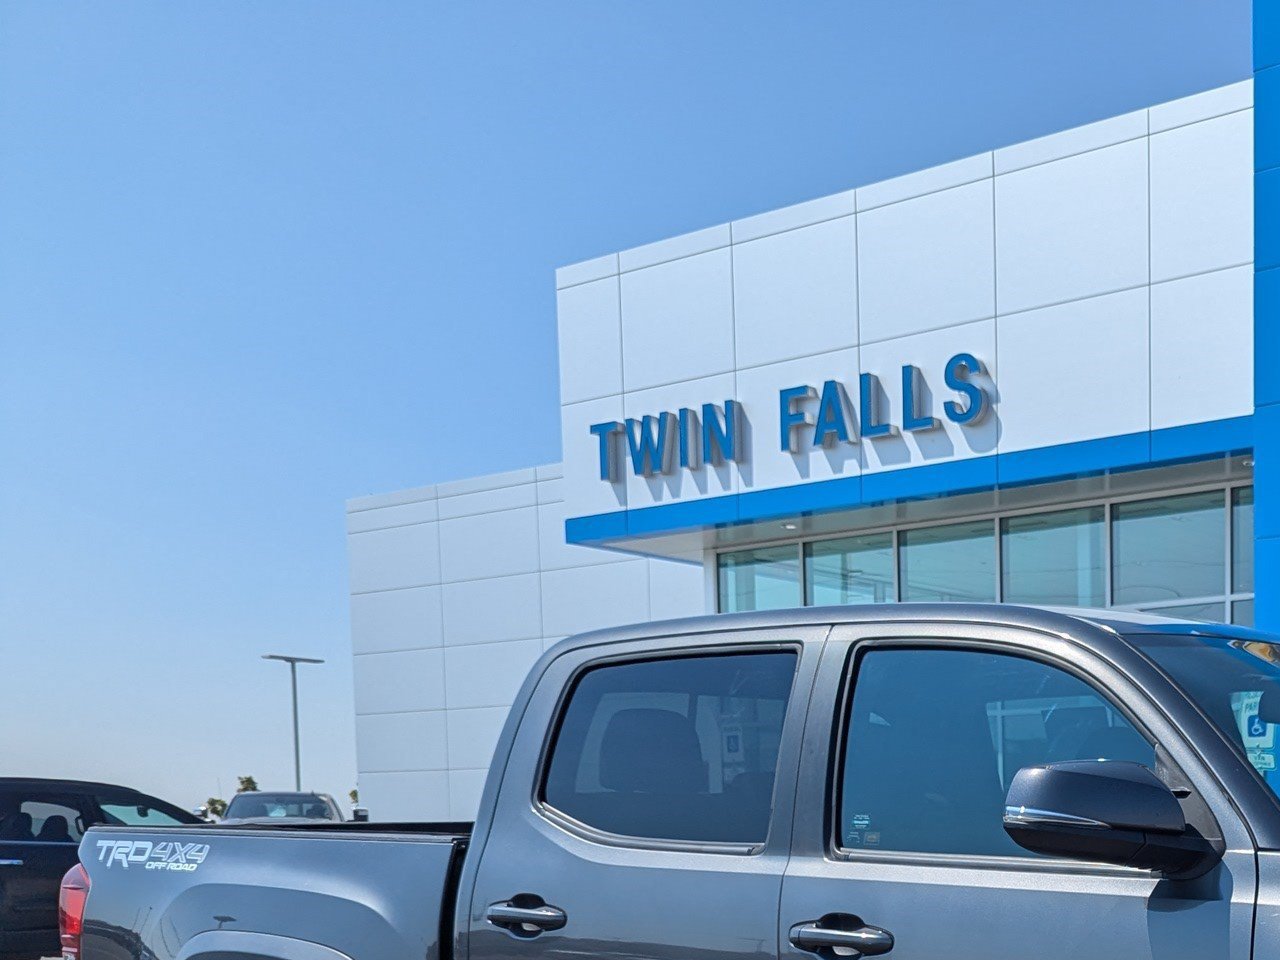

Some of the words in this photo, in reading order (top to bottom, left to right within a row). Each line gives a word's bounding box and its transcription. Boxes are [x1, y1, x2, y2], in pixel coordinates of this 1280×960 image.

[590, 400, 741, 482] TWIN
[779, 353, 985, 453] FALLS
[96, 840, 153, 868] TRD
[145, 861, 167, 870] OFF
[166, 861, 198, 871] ROAD
